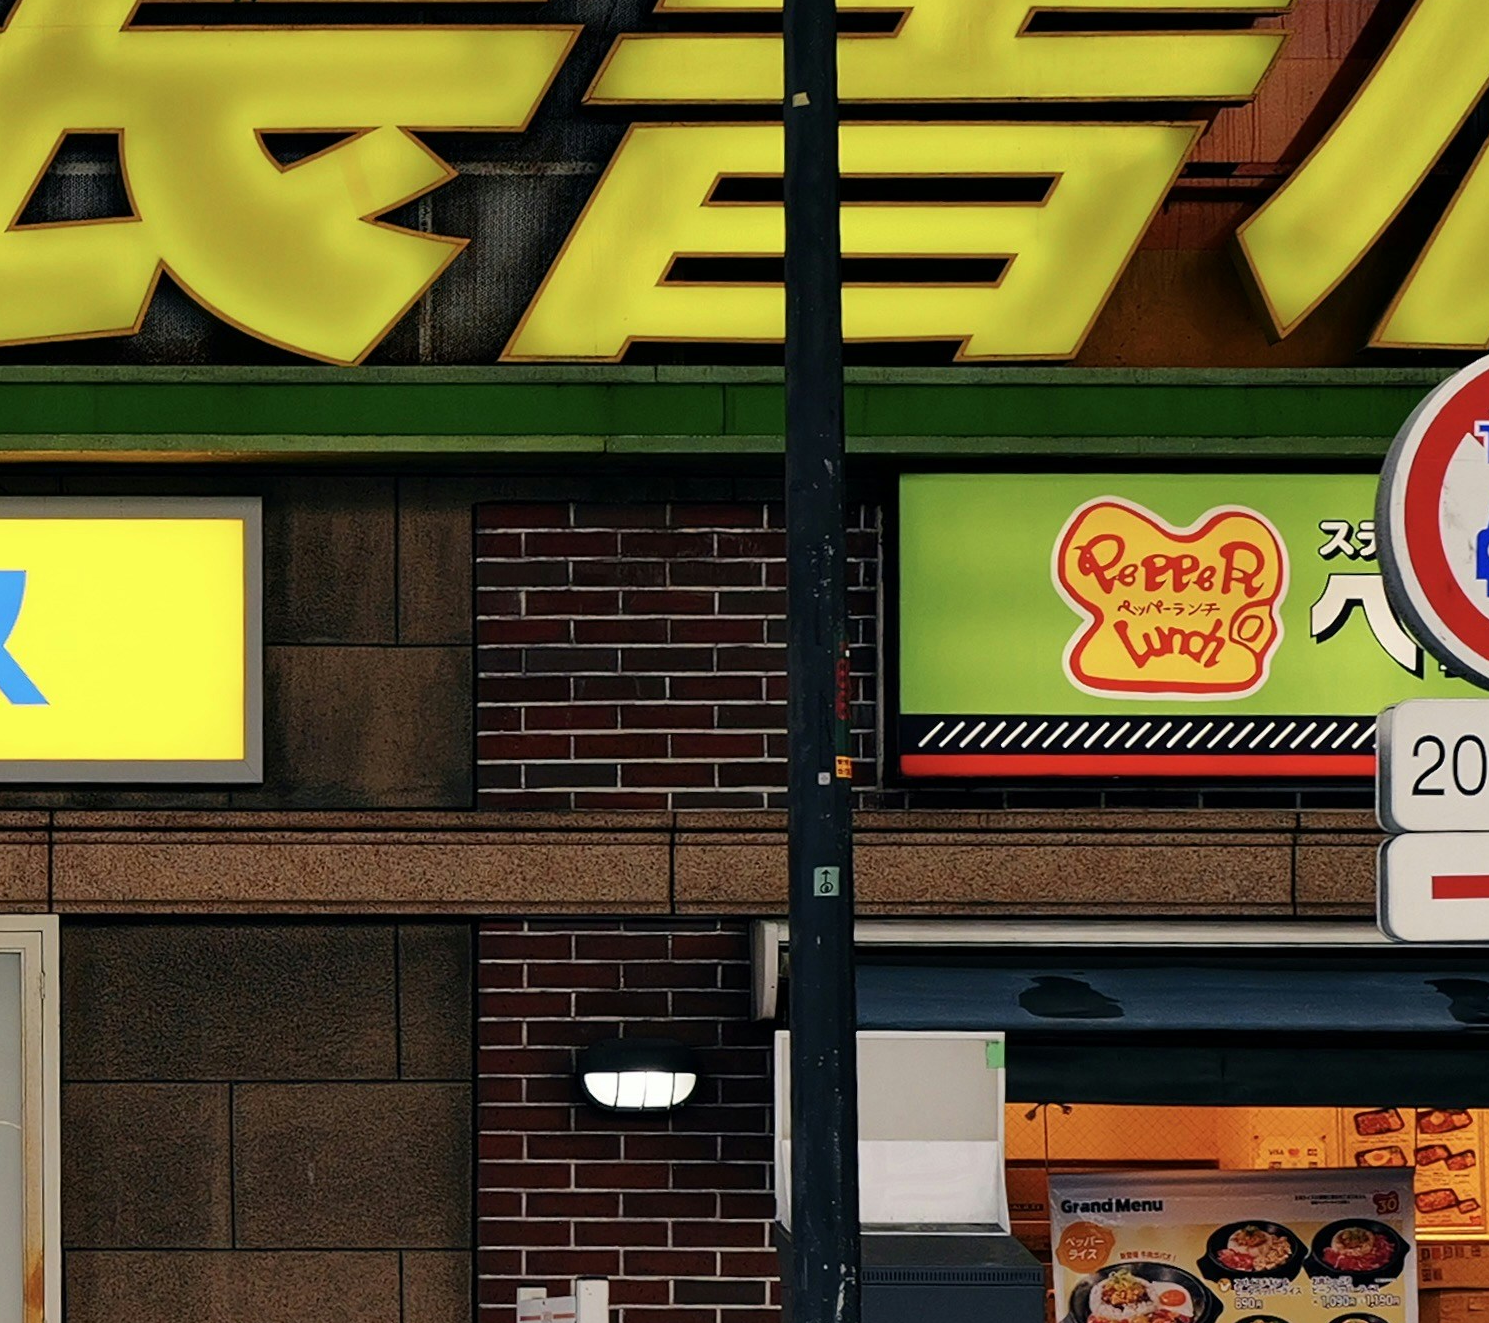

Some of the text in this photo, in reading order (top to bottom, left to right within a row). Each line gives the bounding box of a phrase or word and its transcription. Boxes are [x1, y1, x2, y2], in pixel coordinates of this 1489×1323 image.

[1117, 599, 1221, 616] ペッパーランチ
[1114, 618, 1225, 669] Lunch
[1061, 1198, 1164, 1213] Grand Menu
[1065, 1236, 1105, 1247] ペッパー
[1069, 1249, 1097, 1260] ライス
